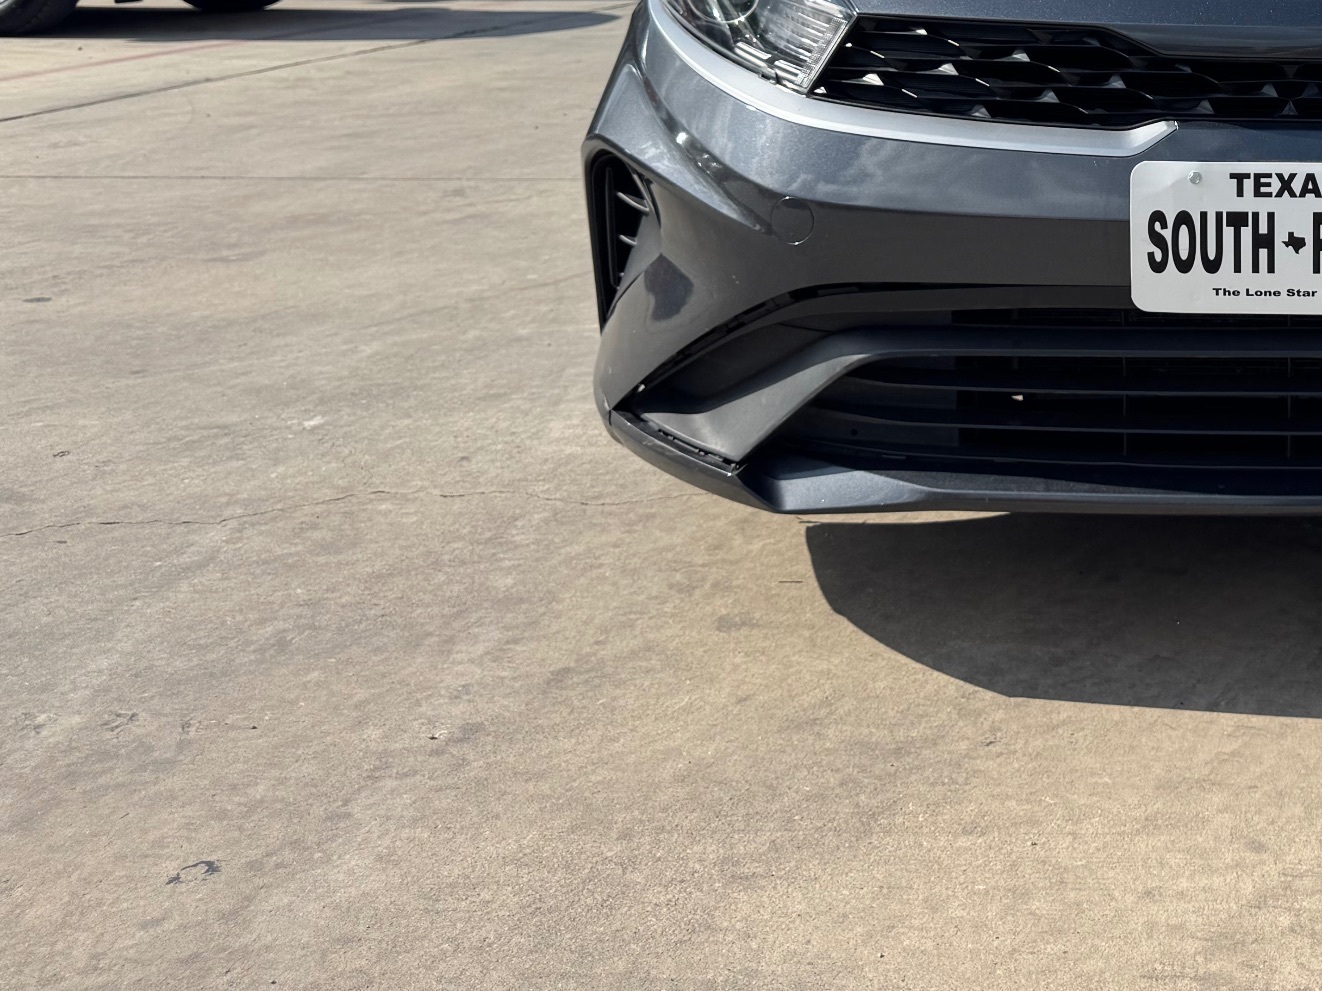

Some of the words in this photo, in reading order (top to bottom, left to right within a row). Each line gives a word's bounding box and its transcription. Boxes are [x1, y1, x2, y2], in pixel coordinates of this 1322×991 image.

[1146, 209, 1276, 275] SOUTH
[1212, 287, 1241, 297] The
[1245, 288, 1282, 297] Lone
[1286, 288, 1318, 298] Star
